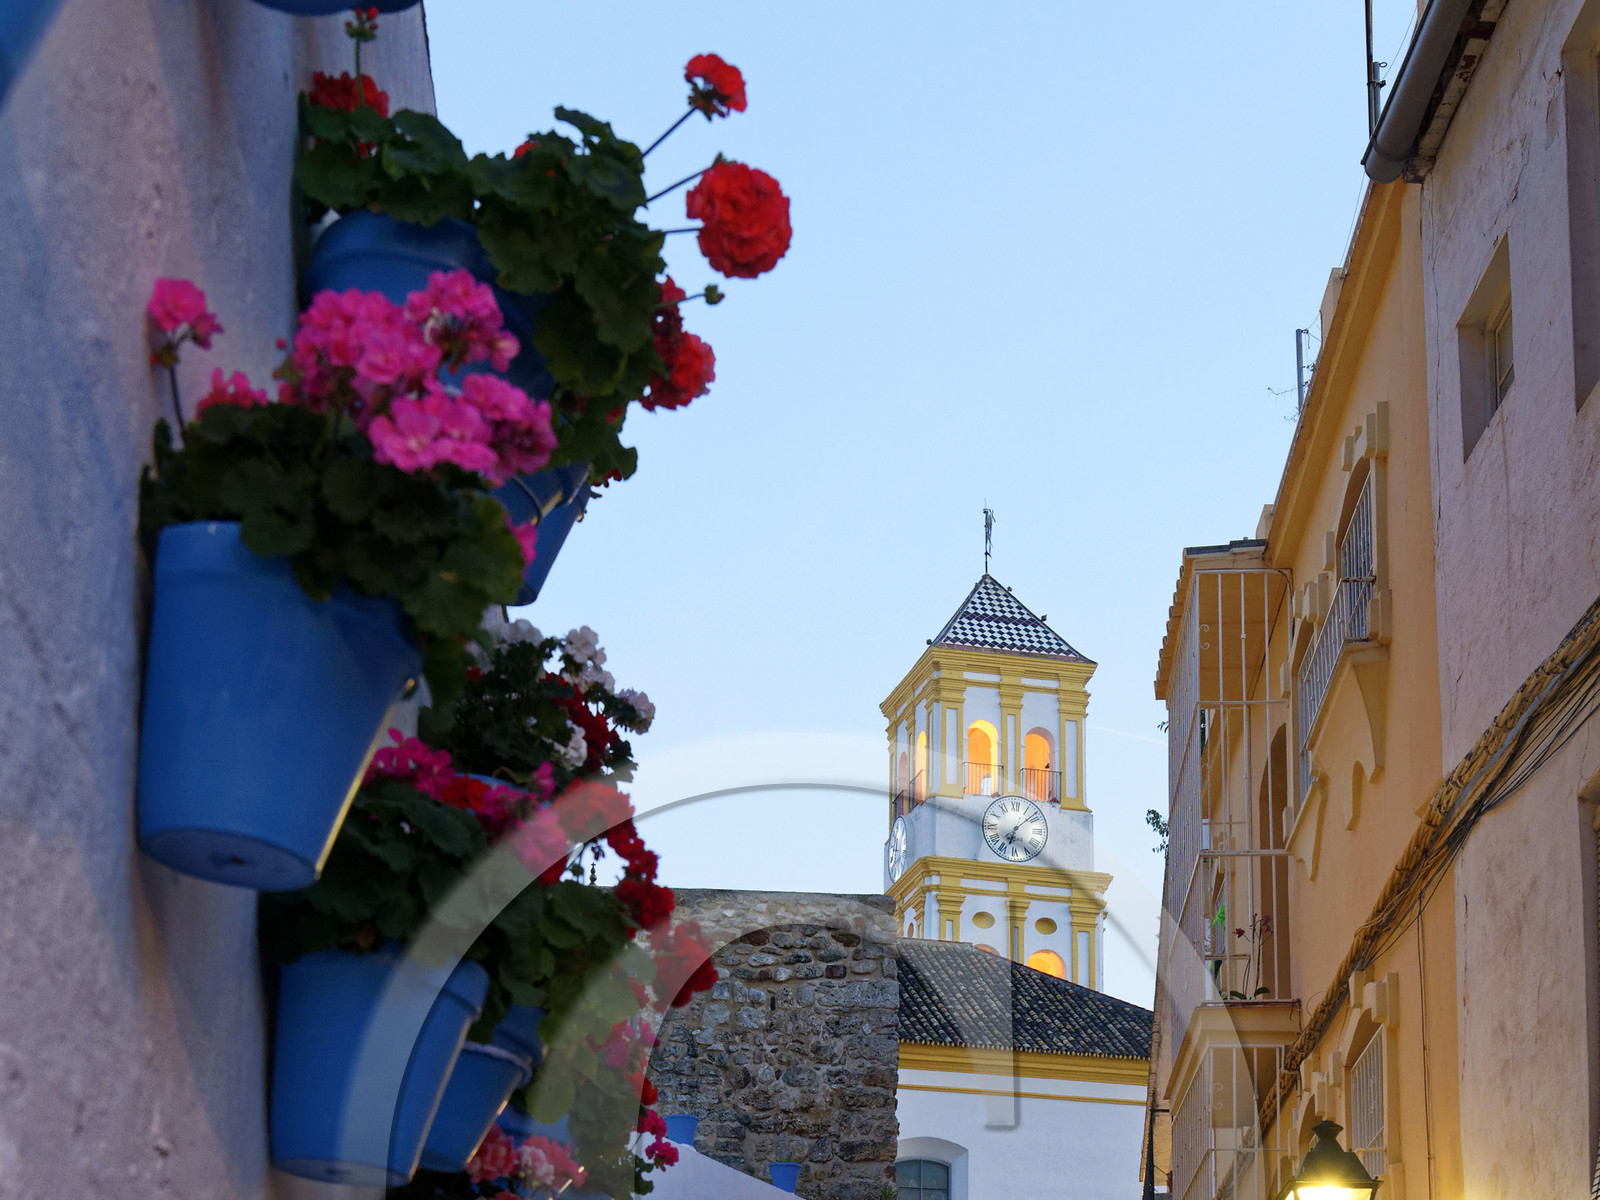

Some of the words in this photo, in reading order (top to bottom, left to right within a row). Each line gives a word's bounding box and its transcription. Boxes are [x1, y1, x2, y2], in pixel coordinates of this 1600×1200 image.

[999, 803, 1008, 814] XI
[1011, 801, 1020, 812] XII
[990, 811, 1000, 820] X
[987, 822, 997, 830] IX
[989, 833, 1000, 846] VIII
[998, 842, 1007, 854] VII
[1012, 847, 1018, 857] VI
[1024, 846, 1031, 855] V
